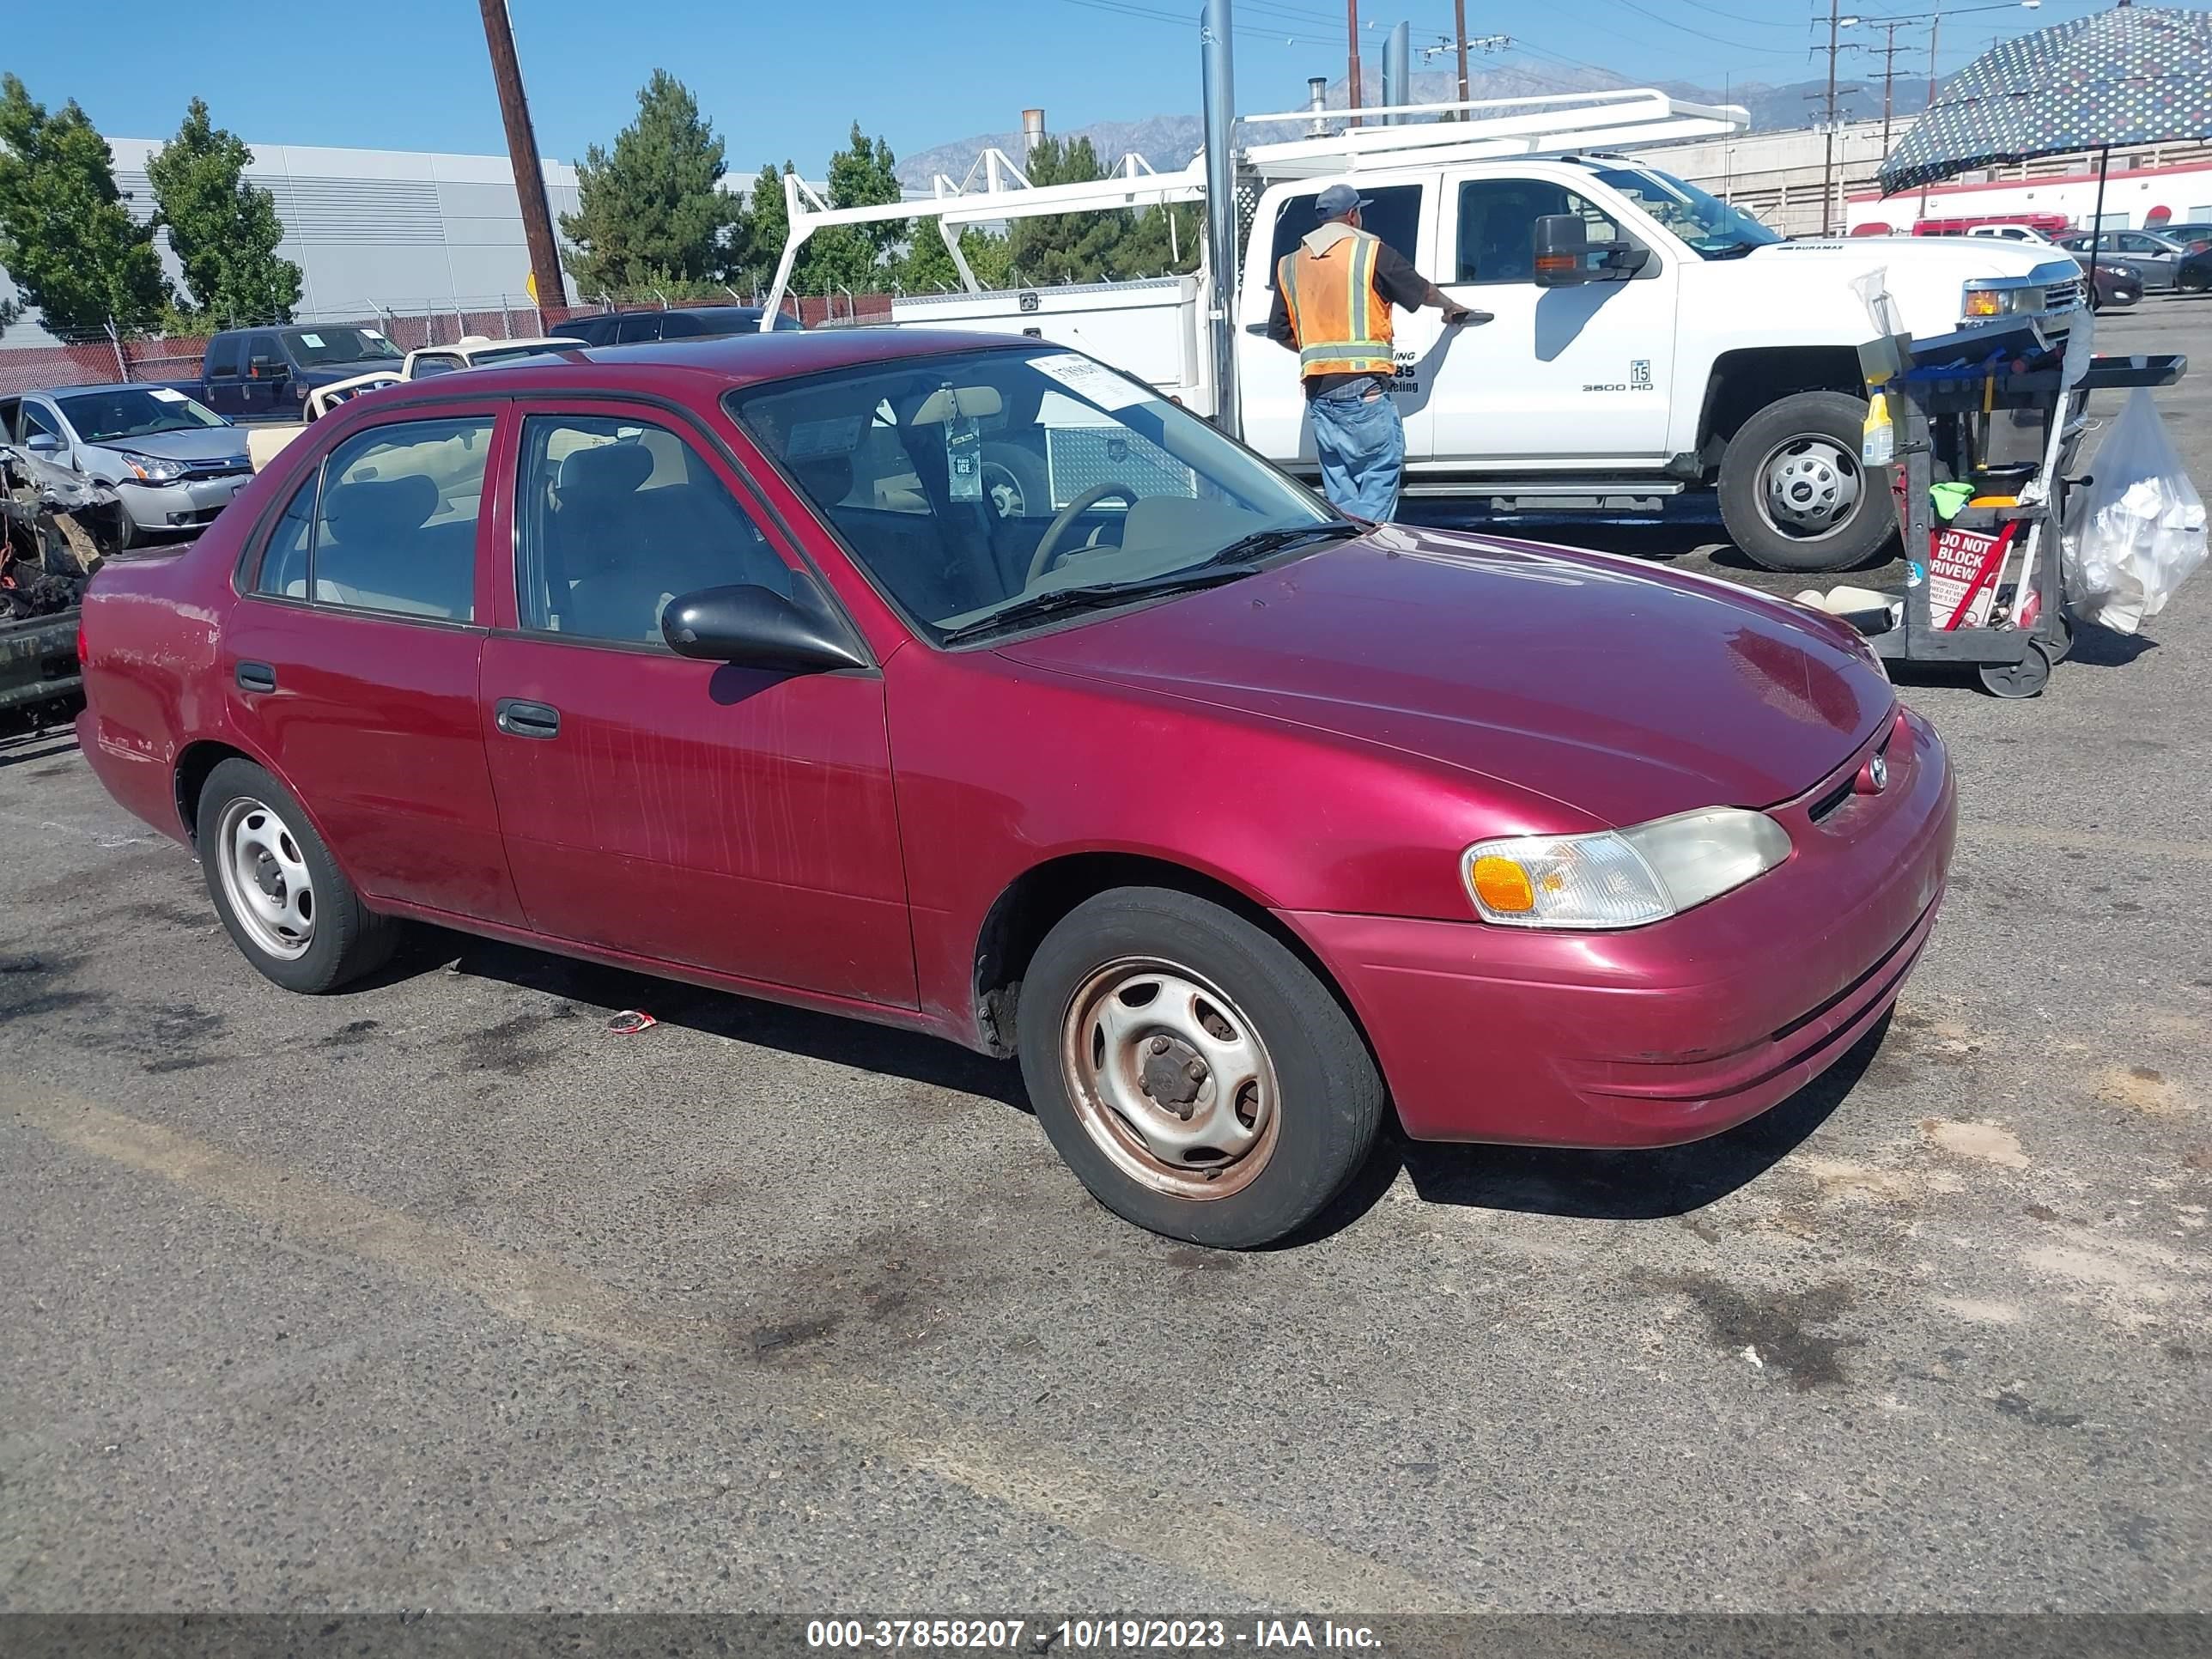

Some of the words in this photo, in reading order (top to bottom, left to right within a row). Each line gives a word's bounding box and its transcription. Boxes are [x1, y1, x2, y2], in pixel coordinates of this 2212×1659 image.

[1393, 349, 1416, 361] ING
[1633, 366, 1649, 381] 15
[957, 464, 970, 473] ICE
[1939, 532, 1960, 548] DO
[1962, 537, 1992, 555] NOT
[1937, 546, 1985, 568] BLOCK
